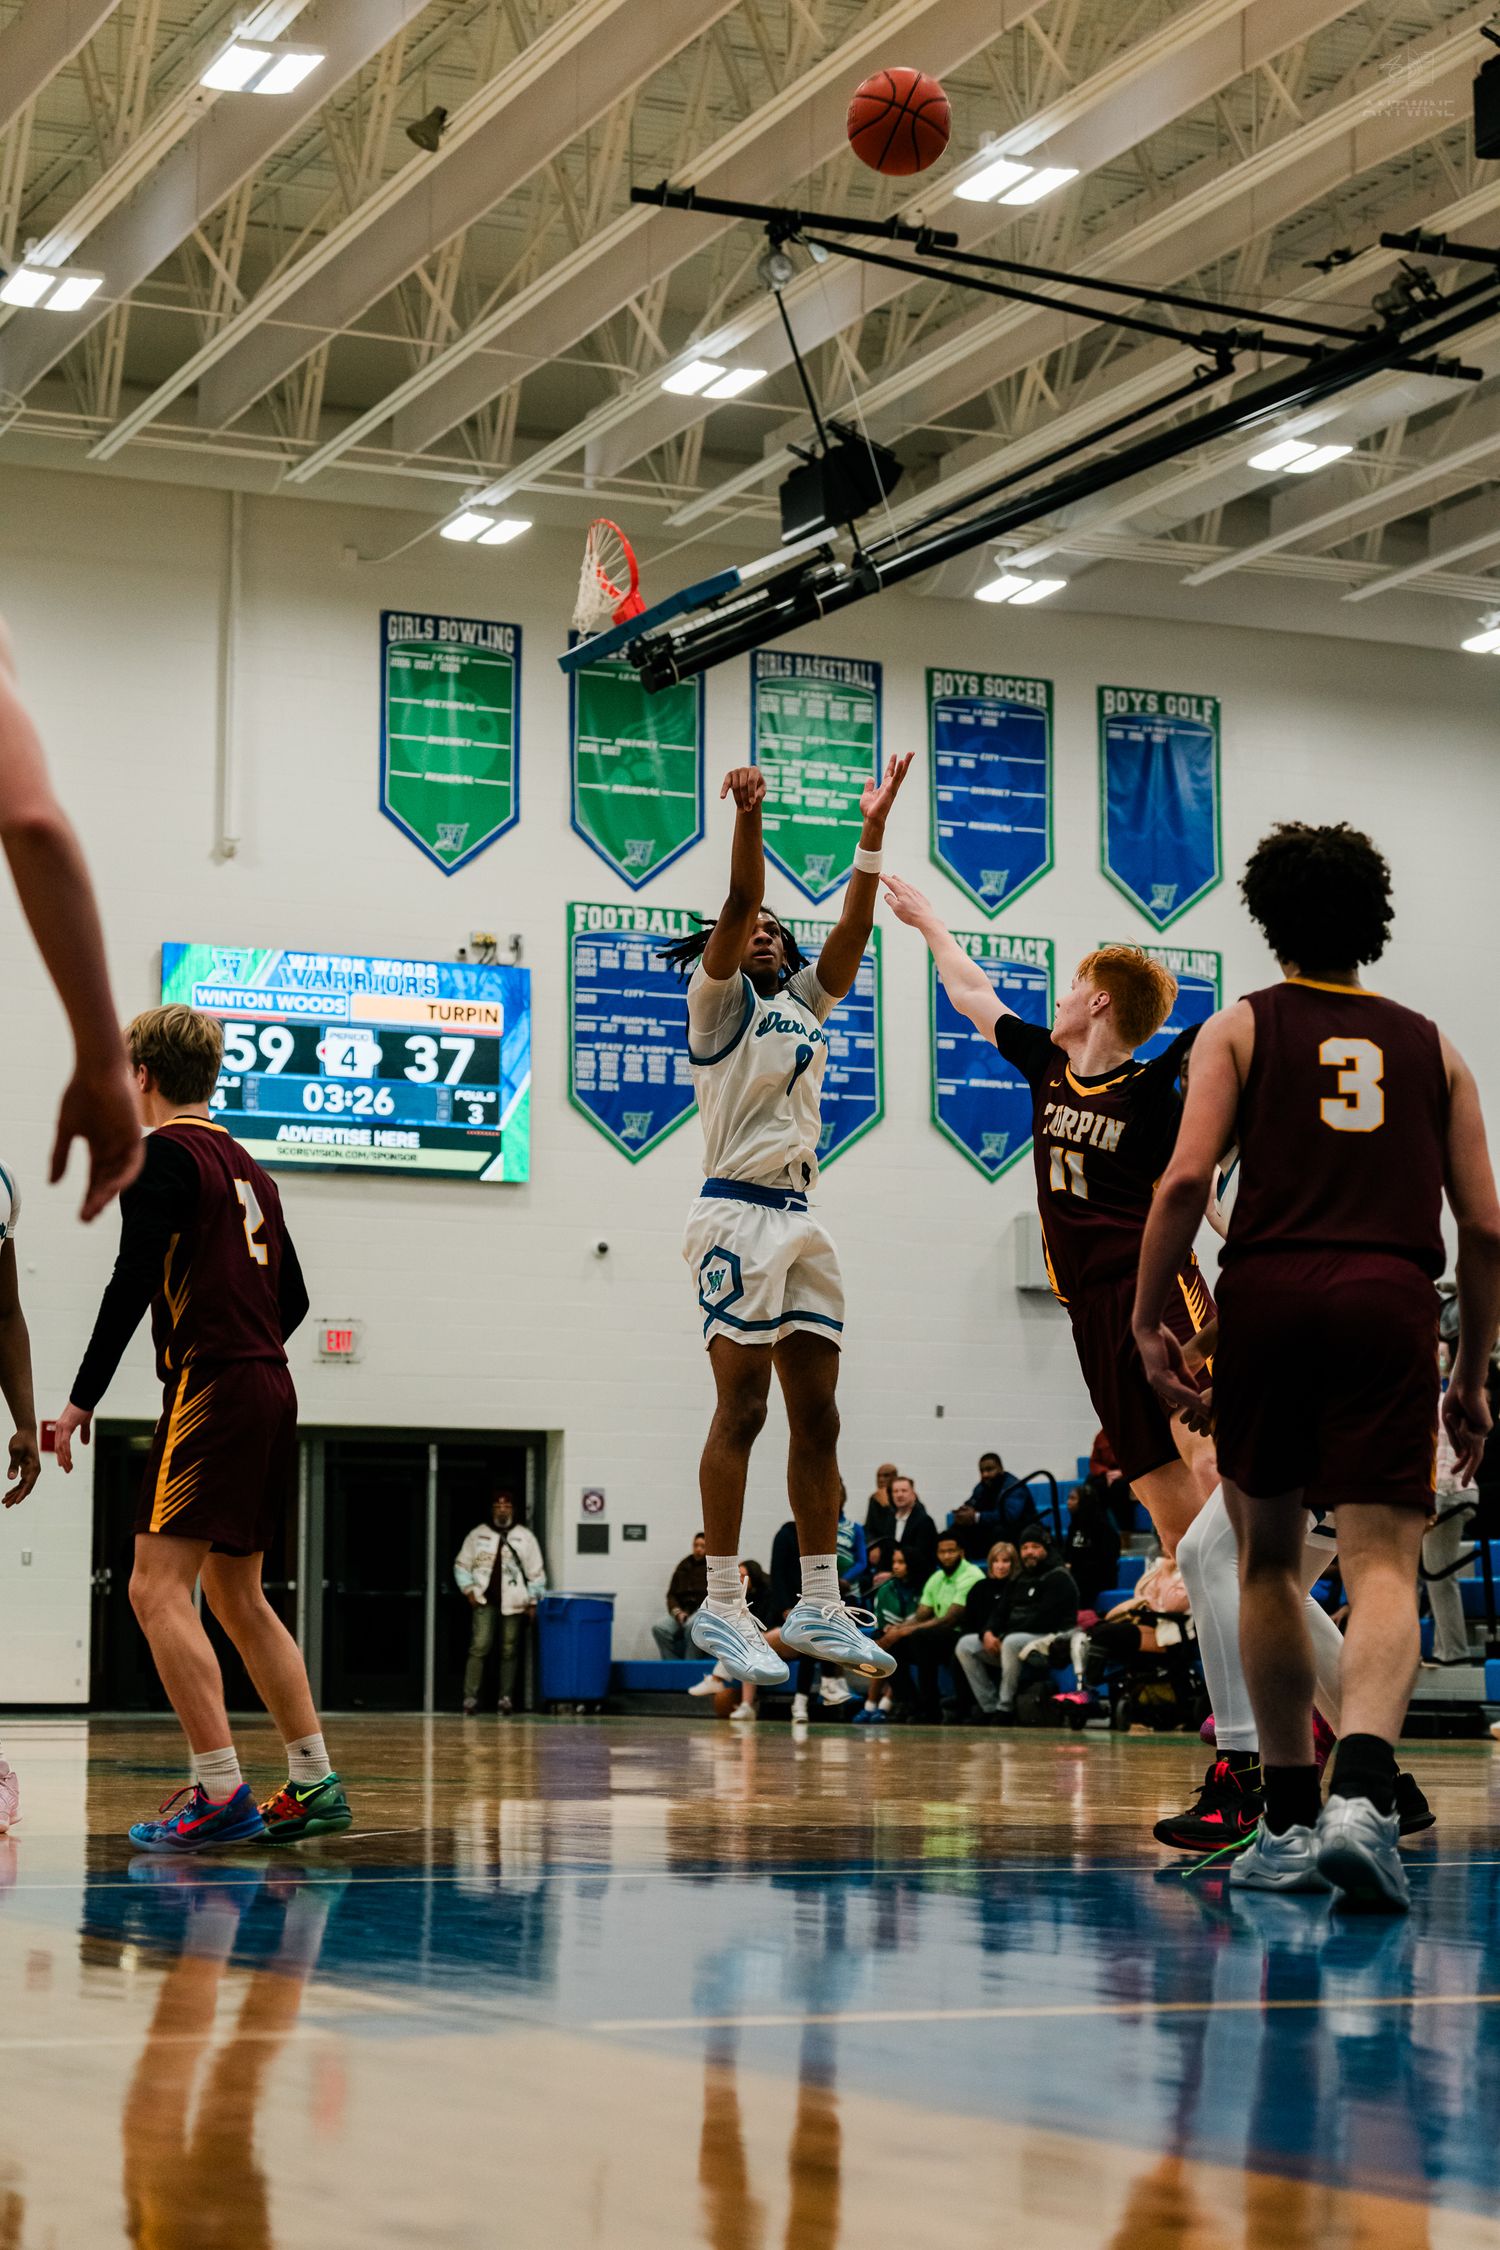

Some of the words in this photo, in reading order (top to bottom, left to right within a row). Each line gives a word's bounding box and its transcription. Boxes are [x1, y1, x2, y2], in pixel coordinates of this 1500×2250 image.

[387, 614, 434, 641] GIRLS
[438, 619, 514, 653] BOWLING
[757, 653, 792, 677] GIRLS
[795, 656, 876, 690] BASKETBALL
[932, 671, 979, 697] BOYS
[983, 676, 1048, 708] SOCCER
[1103, 689, 1159, 715] BOYS
[1165, 695, 1214, 723] GOLF
[573, 904, 695, 936] FOOTBALL
[287, 953, 367, 972] WINTON
[371, 960, 438, 979] WOODS
[987, 936, 1050, 968] TRACK
[279, 964, 440, 997] WARRIORS
[197, 988, 273, 1009] WINTON
[276, 994, 345, 1014] WOODS
[427, 1004, 498, 1023] TURPIN
[222, 1022, 295, 1075] 59
[341, 1046, 357, 1071] 4
[403, 1034, 476, 1086] 37
[210, 1088, 228, 1110] 4
[302, 1082, 395, 1116] 03:26
[1319, 1036, 1385, 1132] 3
[467, 1103, 485, 1125] 3
[1042, 1102, 1127, 1153] TURPIN
[276, 1124, 372, 1146] ADVERTISE
[373, 1129, 420, 1149] HERE
[1049, 1145, 1088, 1200] 11
[327, 1329, 353, 1352] EXIT
